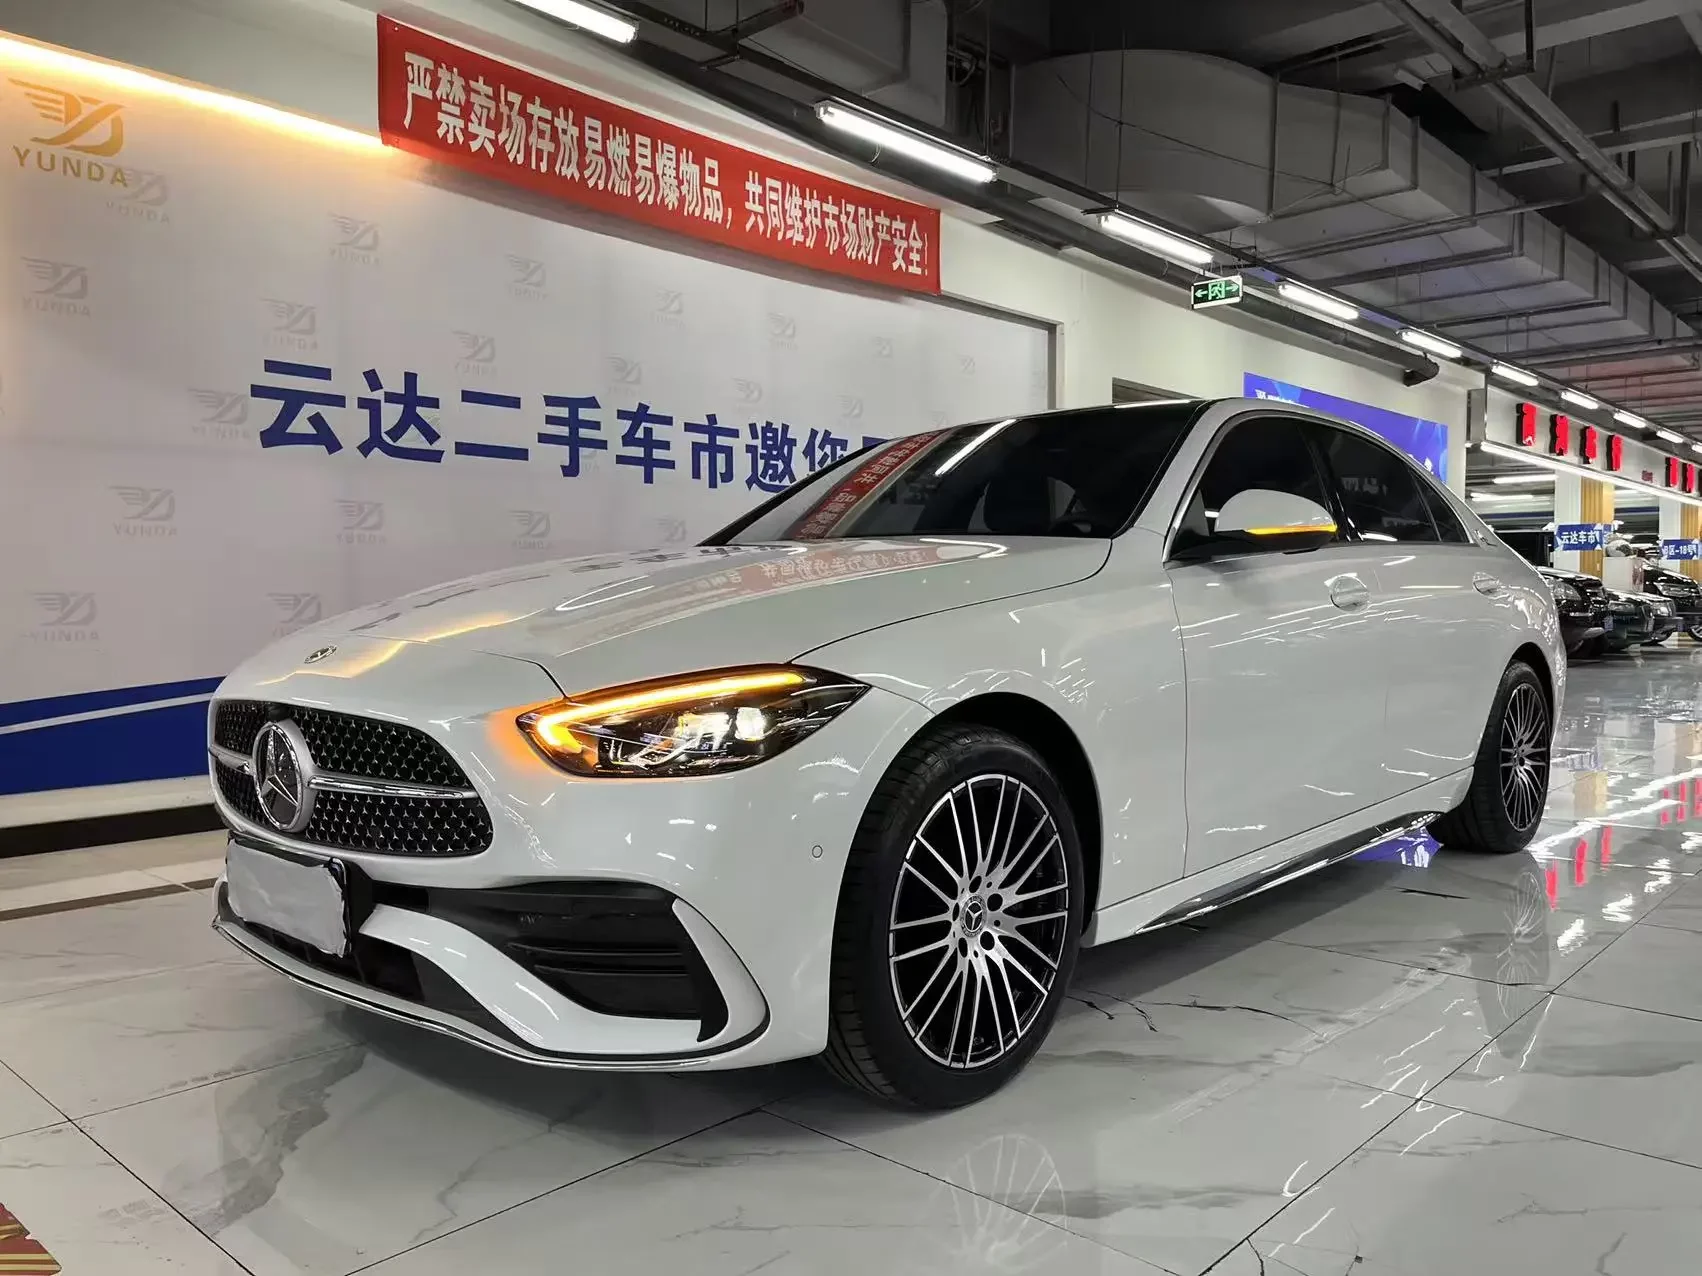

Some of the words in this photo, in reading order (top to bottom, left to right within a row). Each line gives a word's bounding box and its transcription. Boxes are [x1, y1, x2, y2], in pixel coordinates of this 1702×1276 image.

[12, 144, 130, 189] YUNDA
[249, 359, 888, 494] 云达二手车市邀您
